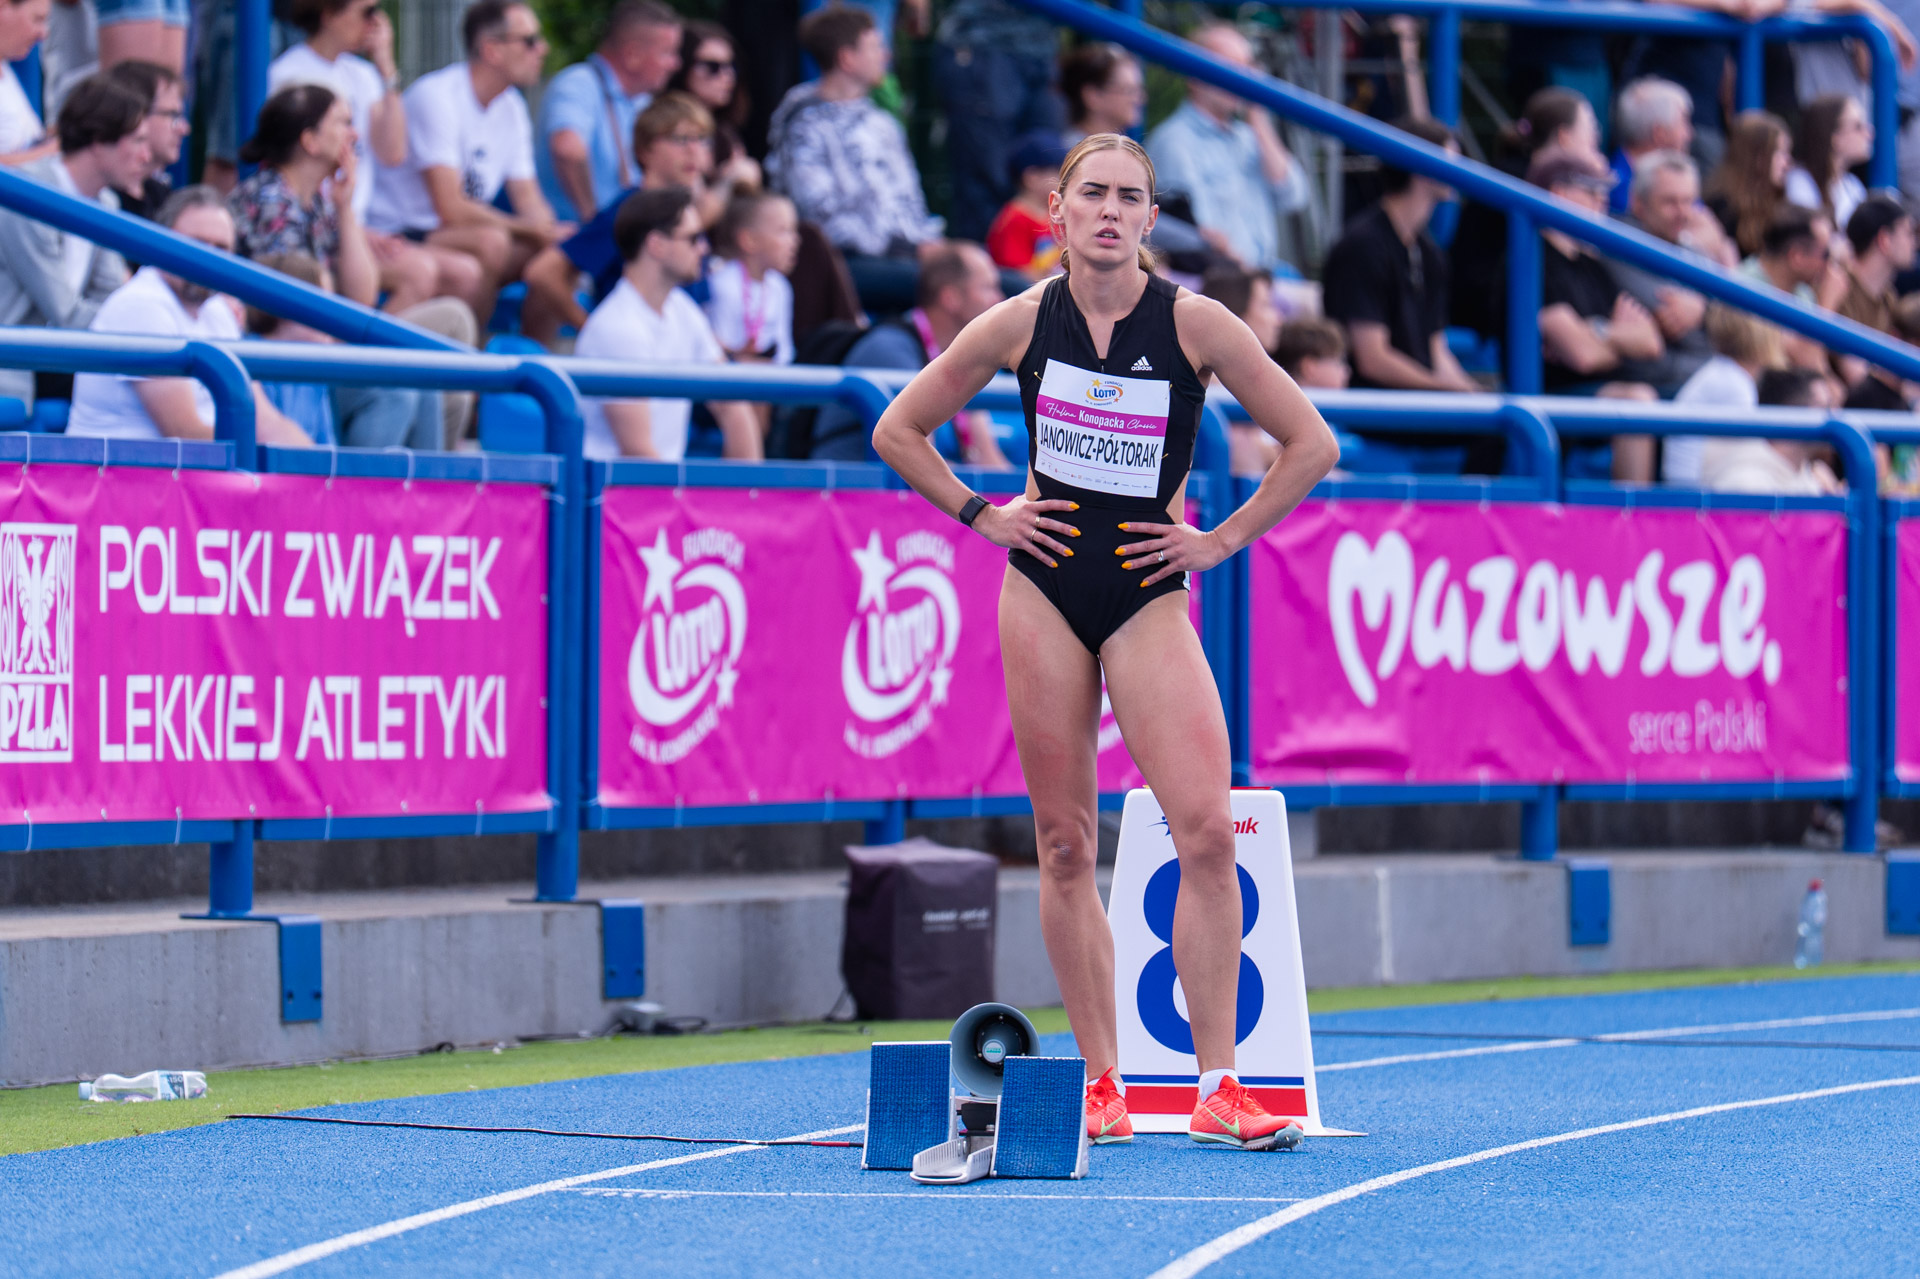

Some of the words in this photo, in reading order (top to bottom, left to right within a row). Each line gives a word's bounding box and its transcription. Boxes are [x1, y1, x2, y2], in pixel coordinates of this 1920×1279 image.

[1046, 402, 1077, 418] Halina
[1078, 409, 1125, 429] Konopacka
[1127, 418, 1157, 430] Classic
[1093, 387, 1117, 398] LOTTO
[1040, 422, 1159, 468] JANOWICZ-PÓŁTORAK
[99, 525, 272, 617] POLSKI
[284, 533, 502, 638] ZWIĄZEK
[651, 594, 726, 692] LOTTO
[867, 595, 939, 690] LOTTO
[0, 682, 69, 751] PZLA
[99, 674, 284, 762] LEKKIEJ
[296, 675, 506, 761] ATLETYKI
[1628, 711, 1692, 754] serce
[1694, 698, 1767, 754] Polski
